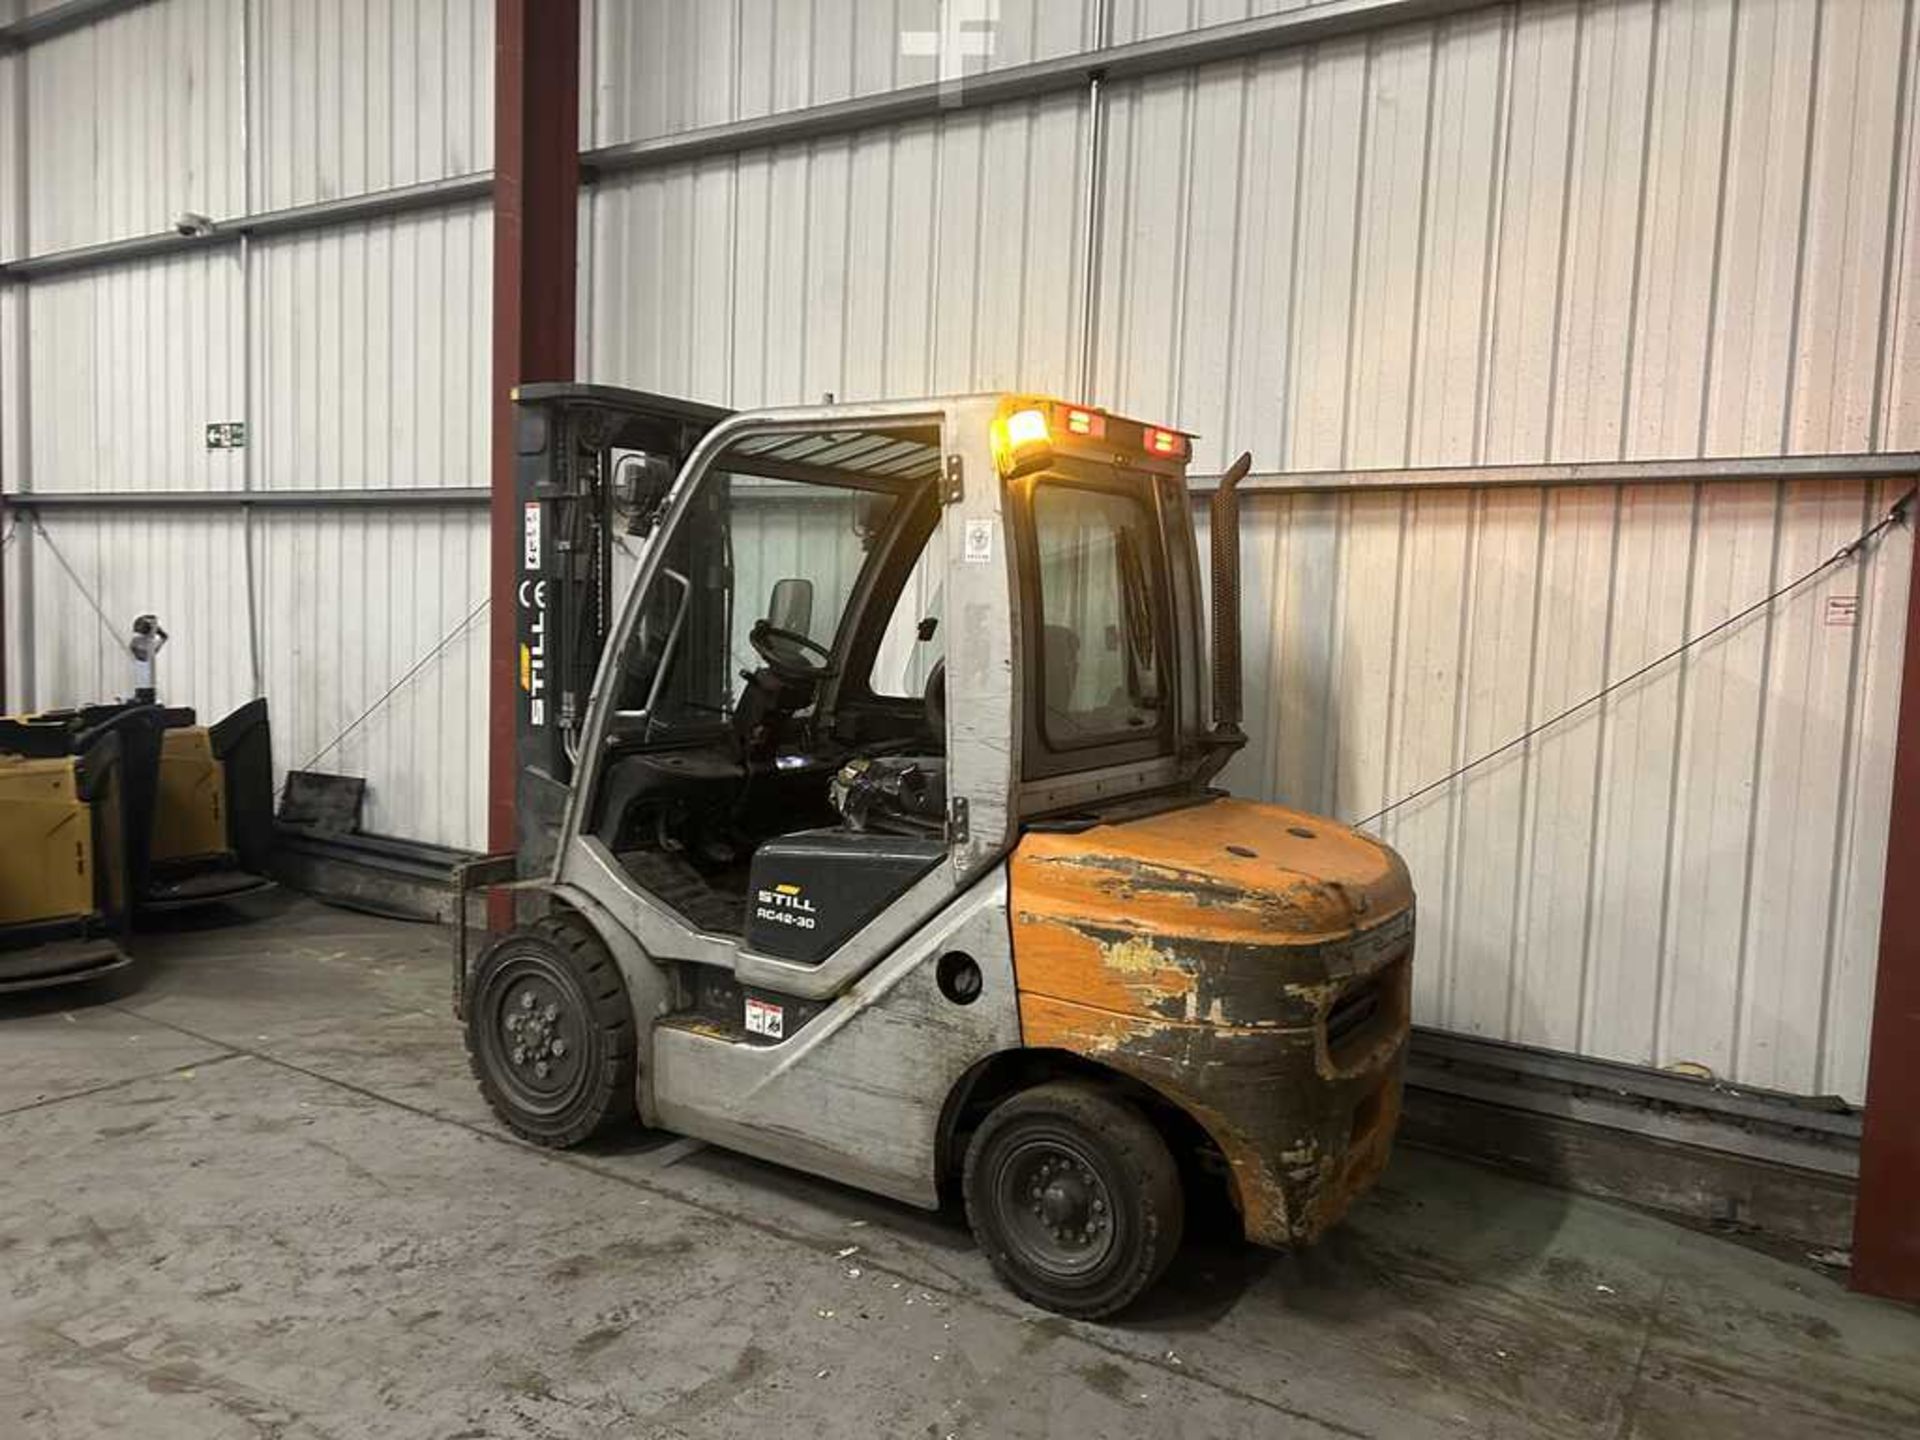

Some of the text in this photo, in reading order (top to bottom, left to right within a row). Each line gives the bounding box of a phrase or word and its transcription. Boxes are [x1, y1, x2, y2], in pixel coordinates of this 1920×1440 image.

[519, 580, 546, 608] CE
[531, 611, 544, 725] STILL
[758, 890, 816, 912] STILL
